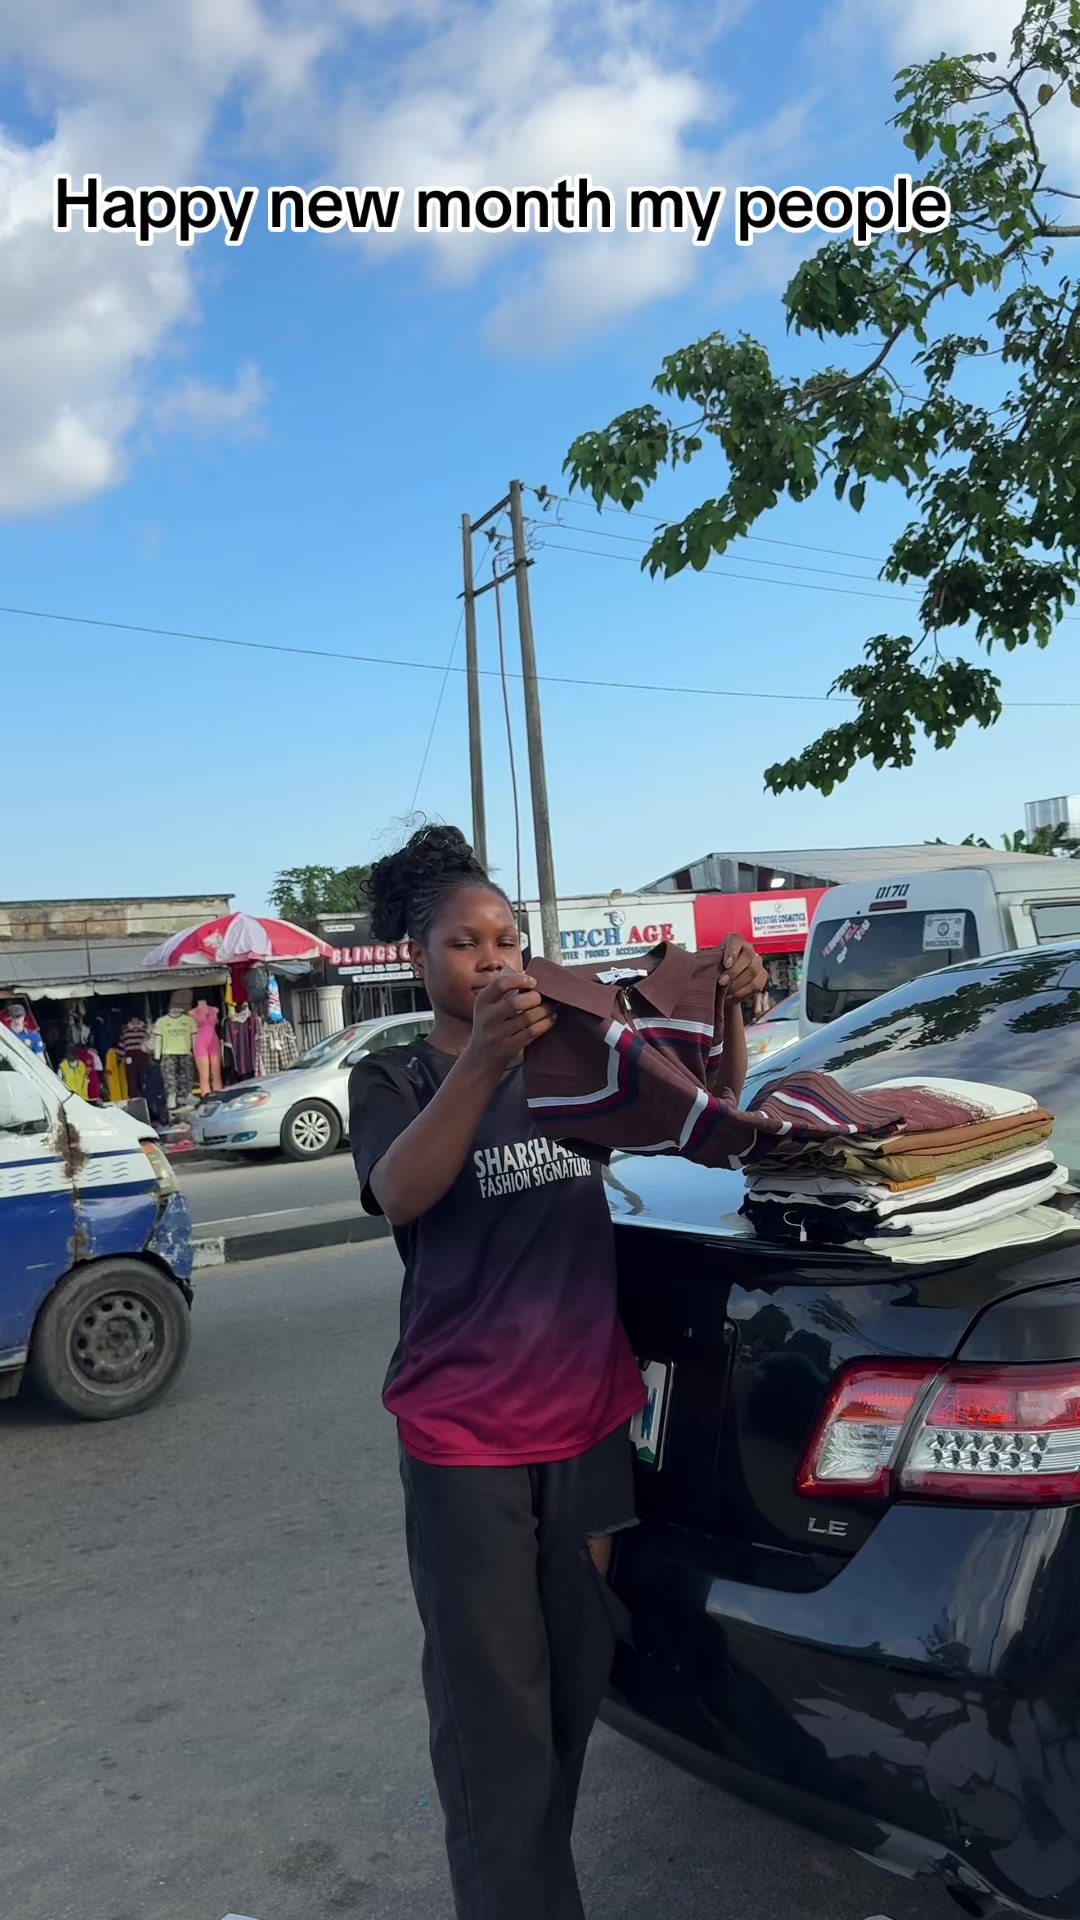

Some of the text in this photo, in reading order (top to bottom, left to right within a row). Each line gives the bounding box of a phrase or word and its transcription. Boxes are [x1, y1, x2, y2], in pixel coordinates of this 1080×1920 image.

[875, 884, 910, 900] 0170
[560, 923, 674, 948] TECH AGE
[331, 945, 397, 965] BLINGS
[473, 1136, 580, 1179] SHARSHA
[479, 1169, 532, 1199] FASHION
[808, 1517, 848, 1536] LE
